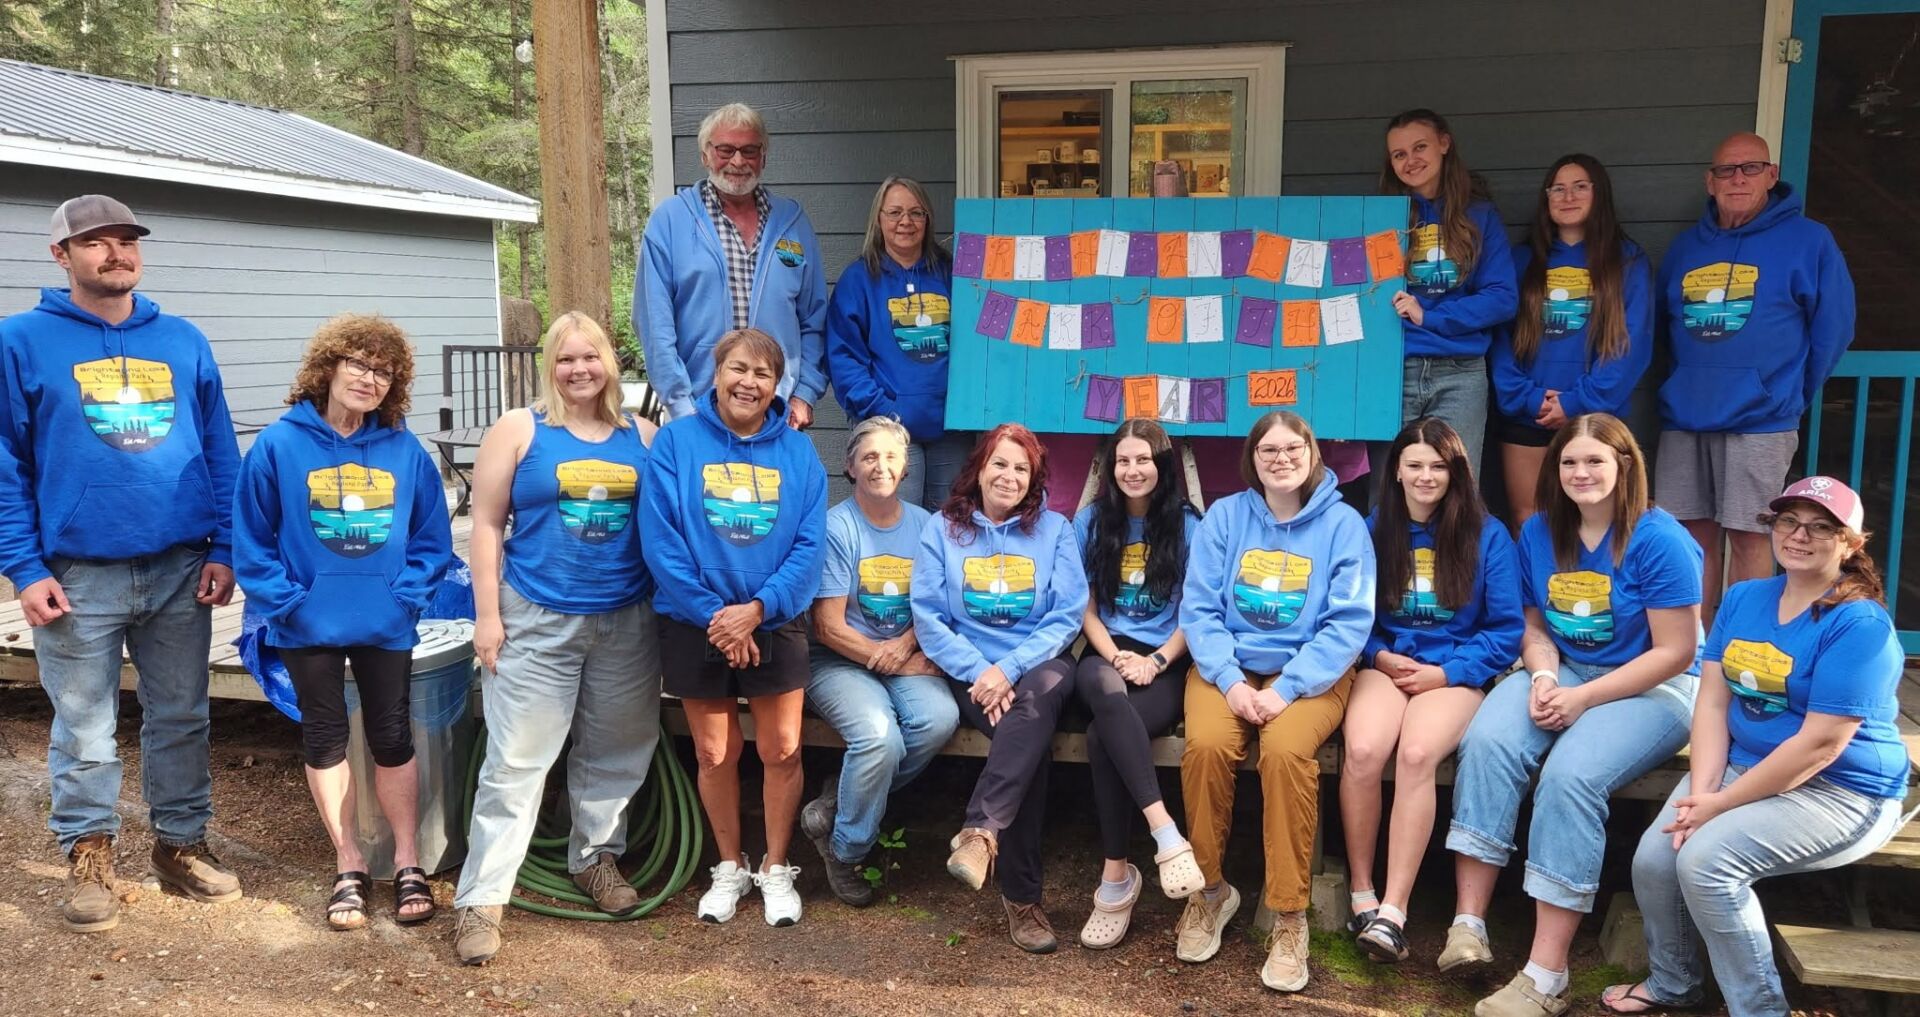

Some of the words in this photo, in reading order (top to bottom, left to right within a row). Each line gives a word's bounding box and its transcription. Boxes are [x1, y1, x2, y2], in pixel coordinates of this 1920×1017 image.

[955, 231, 1252, 281] BRIGHTSAN
[980, 292, 1114, 348] PARK
[1152, 299, 1218, 341] OF
[1243, 297, 1359, 345] THE
[1094, 376, 1222, 422] YEAR
[1254, 376, 1295, 401] 2026
[1797, 489, 1833, 501] ARIAT
